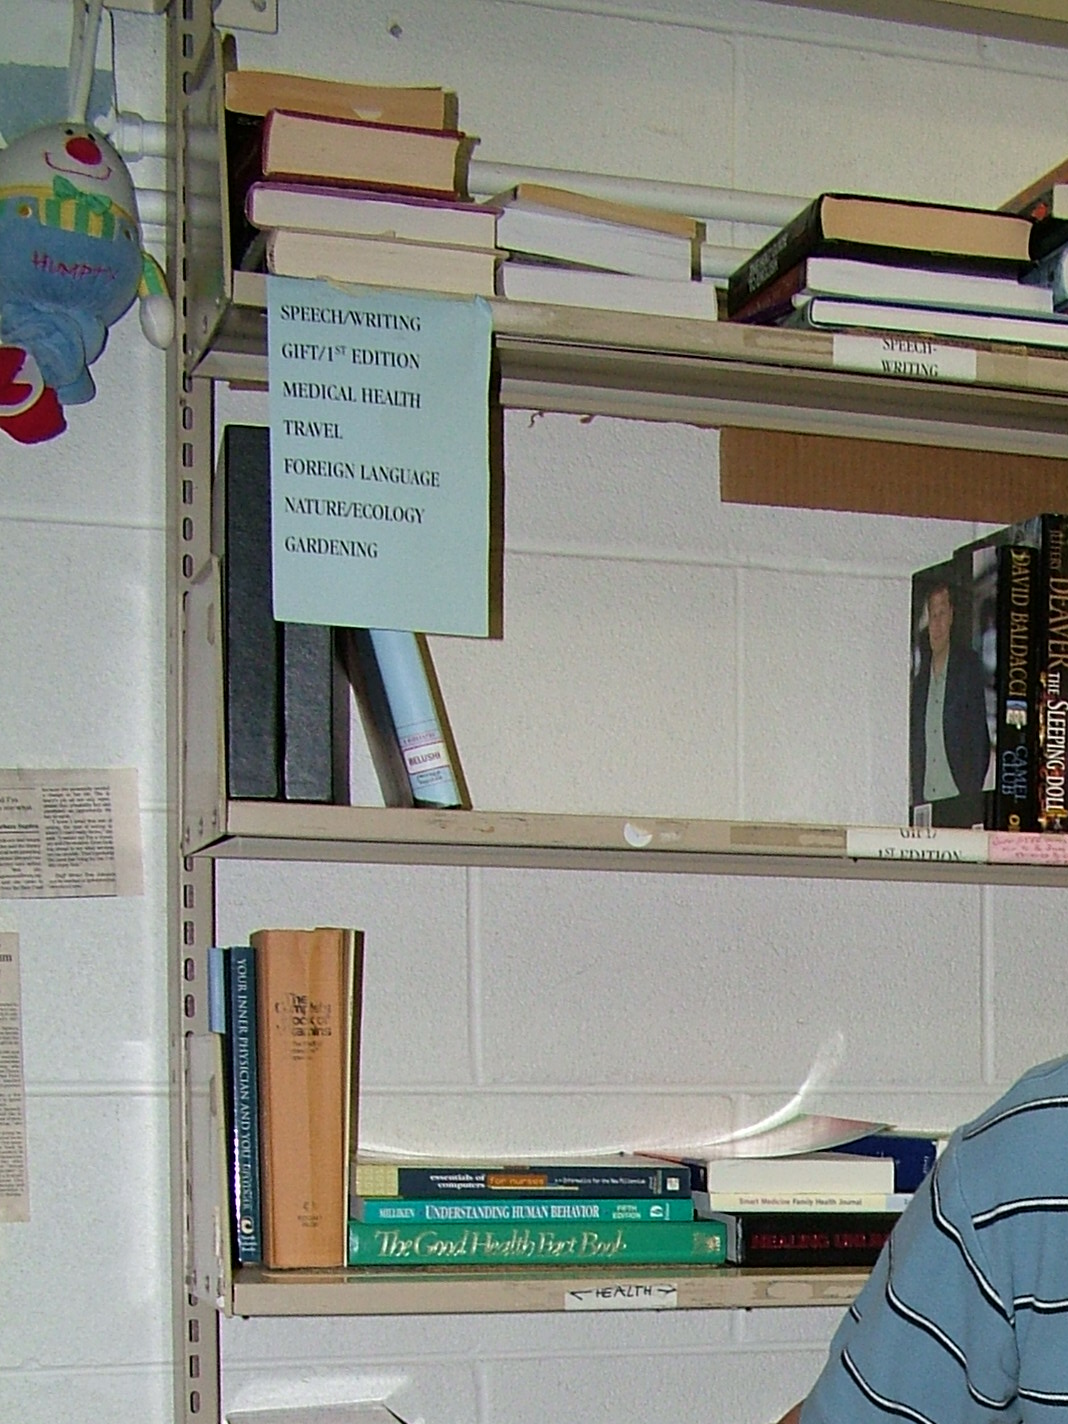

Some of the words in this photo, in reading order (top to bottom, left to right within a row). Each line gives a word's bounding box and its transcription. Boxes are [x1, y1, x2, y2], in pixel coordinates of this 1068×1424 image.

[280, 305, 421, 331] SPEECH/WRITING
[352, 348, 420, 369] EDITION
[881, 360, 938, 377] WRITING
[282, 381, 357, 402] MEDICAL
[362, 387, 421, 409] HEALTH
[283, 420, 343, 439] TRAVEL
[284, 458, 354, 478] FOREIGN
[361, 464, 440, 487] LANGUAGE
[285, 496, 425, 524] NATURE/ECOLOGY
[285, 536, 378, 558] GARDENING
[1010, 549, 1031, 607] DAVID
[1009, 611, 1029, 697] BALDACCI
[1048, 672, 1060, 694] THE
[1045, 775, 1065, 812] DOLL
[237, 958, 247, 991] YOUR
[238, 995, 248, 1033] INNER
[239, 1037, 249, 1098] PHYSICIAN
[240, 1103, 250, 1130] AND
[241, 1132, 251, 1158] YOU
[429, 1174, 469, 1182] essentials
[472, 1173, 486, 1182] of
[437, 1182, 487, 1190] computers
[425, 1205, 510, 1219] UNDERSTANDING
[511, 1205, 549, 1219] HUMAN
[551, 1205, 600, 1219] BEHAVIOR
[792, 1198, 814, 1207] Family
[815, 1198, 836, 1206] Health
[838, 1198, 862, 1206] Journal
[374, 1229, 413, 1257] The
[414, 1229, 467, 1257] Good
[472, 1228, 537, 1257] Health
[538, 1232, 577, 1257] Fact
[596, 1285, 652, 1298] HEALTH
